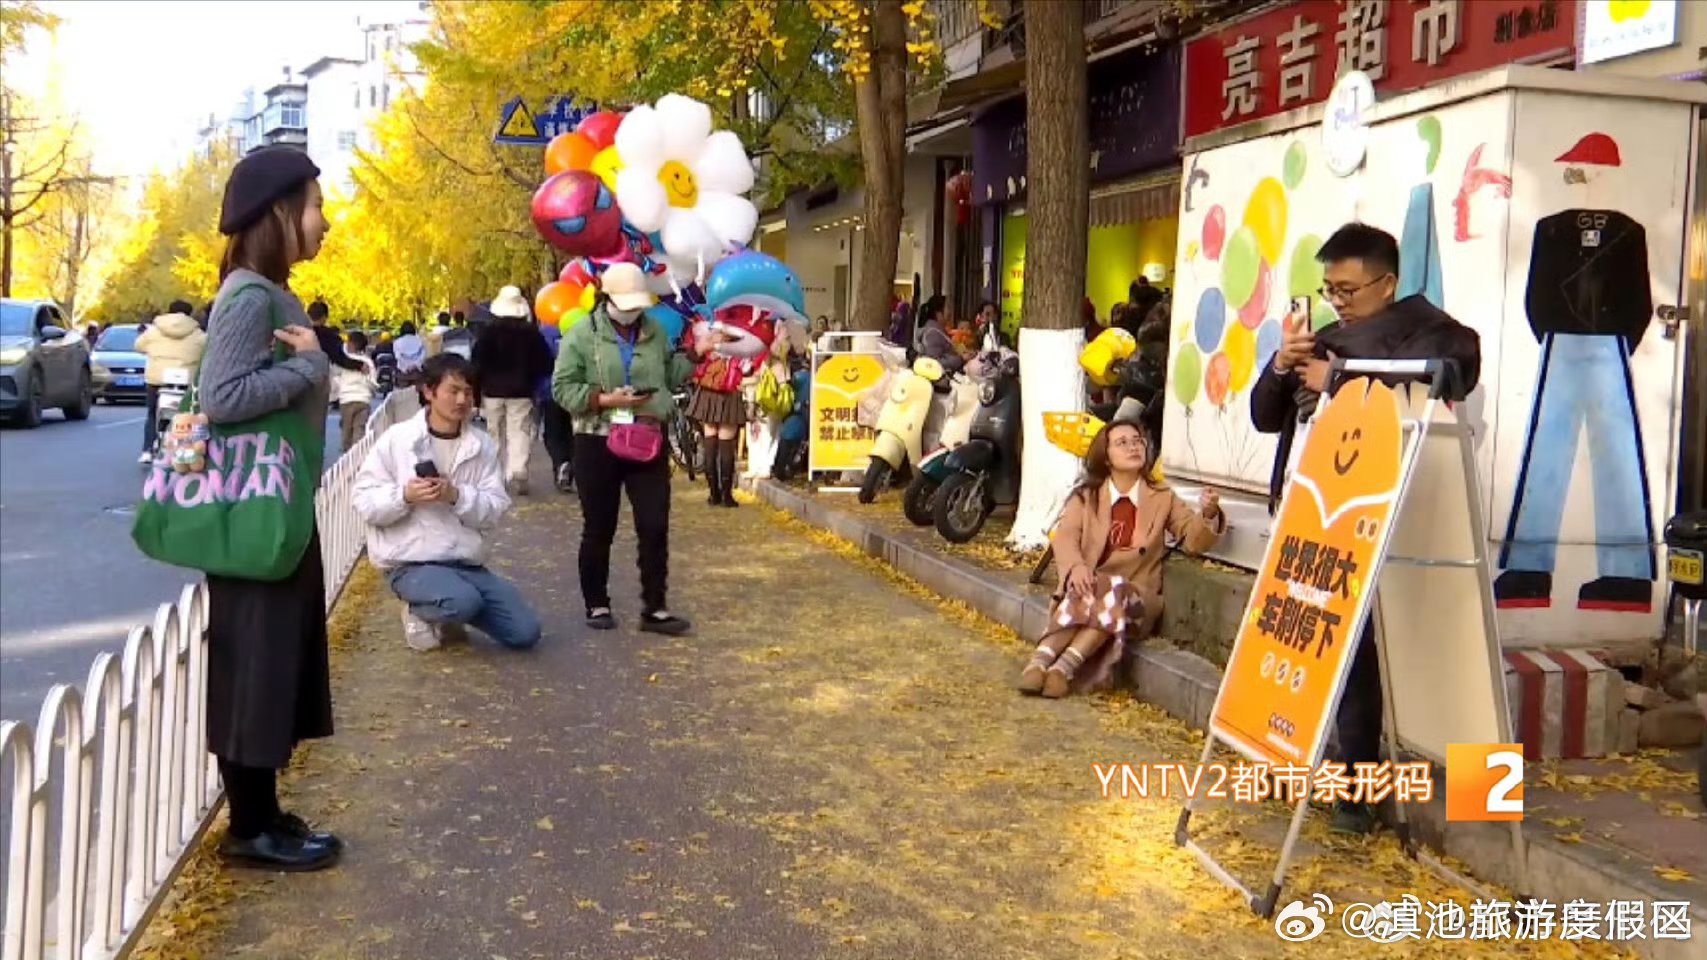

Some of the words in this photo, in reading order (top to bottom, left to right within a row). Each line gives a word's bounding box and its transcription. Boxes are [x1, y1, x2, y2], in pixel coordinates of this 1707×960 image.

[1220, 1, 1464, 121] 亮吉超市
[143, 463, 293, 508] WOMAN
[1274, 534, 1358, 601] 世界很大
